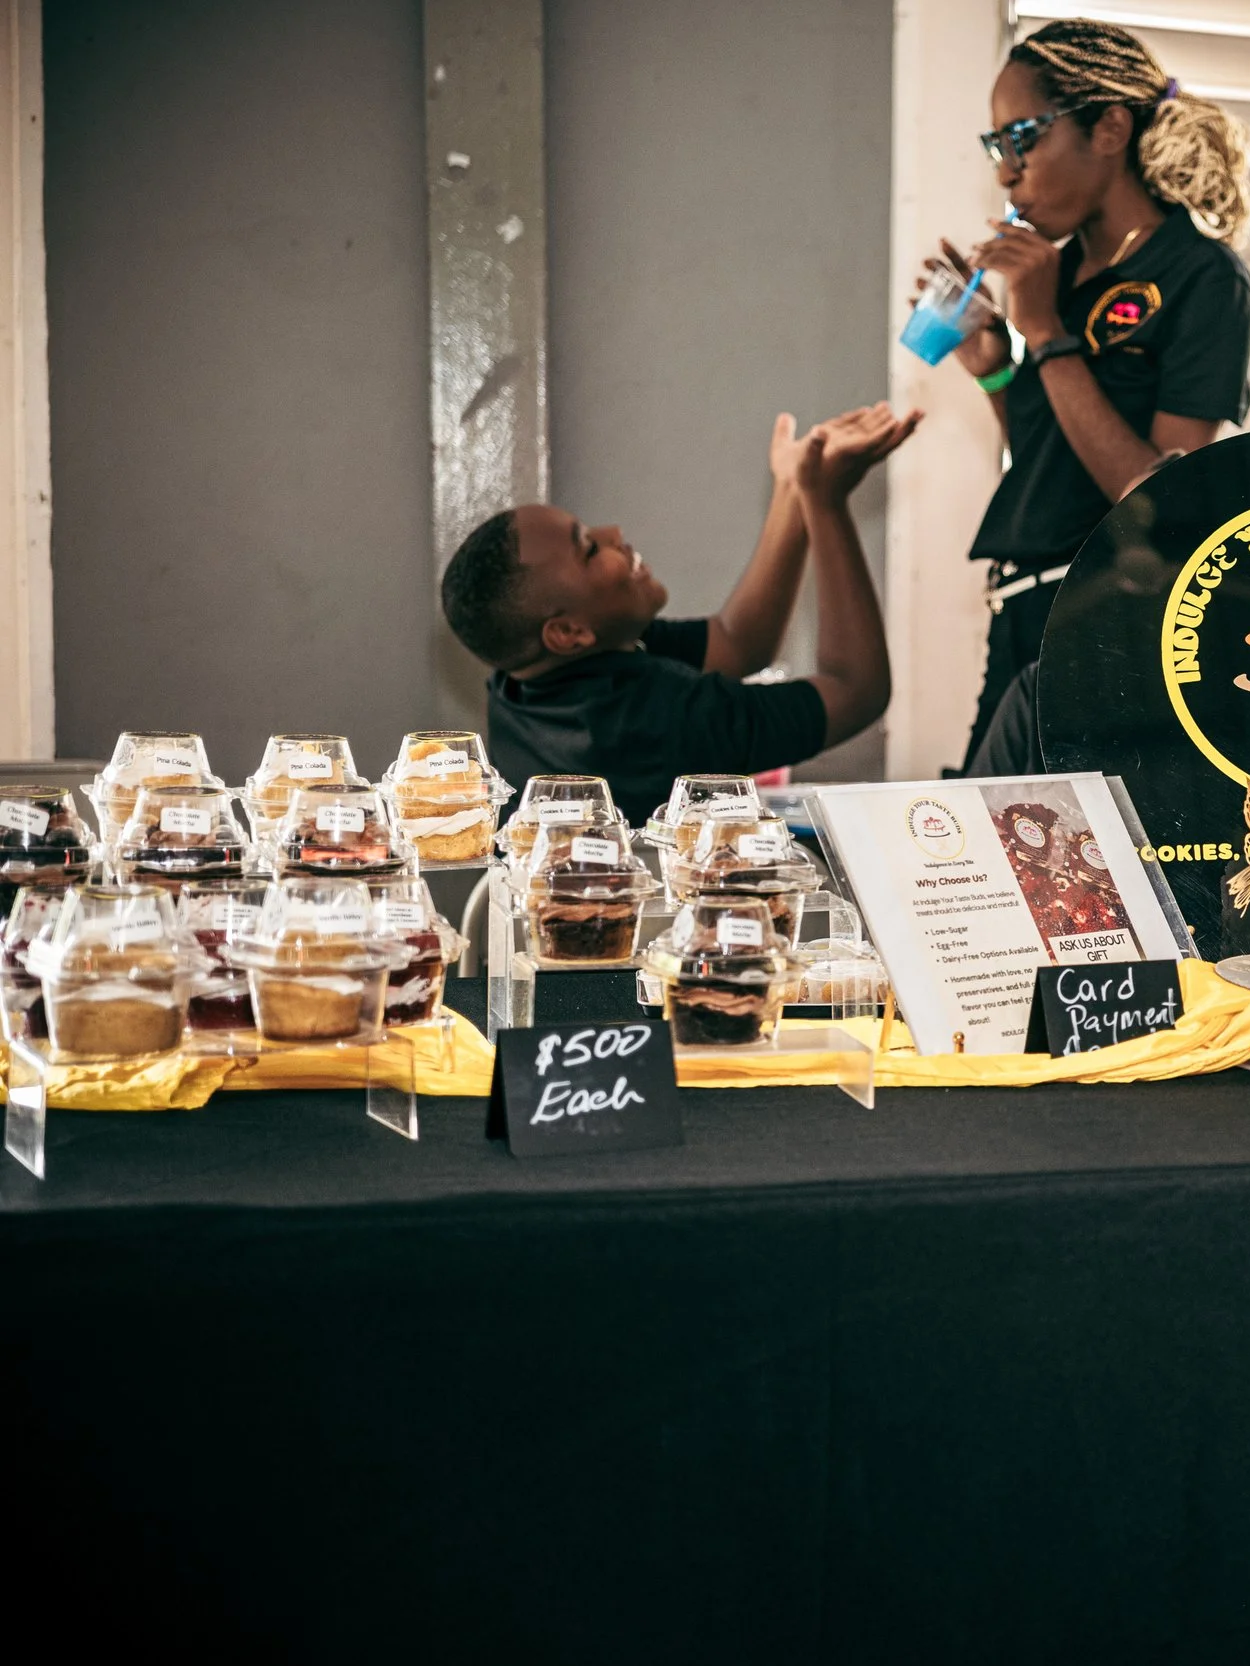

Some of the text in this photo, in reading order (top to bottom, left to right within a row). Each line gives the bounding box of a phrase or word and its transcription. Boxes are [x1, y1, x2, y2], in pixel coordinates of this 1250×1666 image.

[1173, 544, 1238, 684] INDULGE
[443, 757, 465, 766] Colada
[168, 811, 200, 820] Choolate
[325, 810, 357, 819] Choolate
[1135, 843, 1241, 863] OOKIES,
[916, 873, 988, 888] Why Choose Us?
[930, 926, 968, 936] Low-Sugar
[936, 940, 969, 951] Egg-Free
[1059, 933, 1127, 952] ASK US ABOUT
[942, 945, 1039, 964] Dairy-Free Options Available
[1087, 950, 1109, 962] GIFT
[950, 973, 990, 983] Homemade
[991, 970, 1006, 979] with
[1006, 969, 1023, 977] love,
[956, 985, 1006, 998] preservatives,
[1005, 982, 1020, 991] and
[1019, 981, 1030, 989] full
[1056, 966, 1136, 1005] Card
[983, 1002, 997, 1011] you
[1010, 996, 1024, 1004] feel
[1065, 988, 1178, 1044] Payment
[535, 1025, 652, 1076] $500
[530, 1076, 645, 1125] Each
